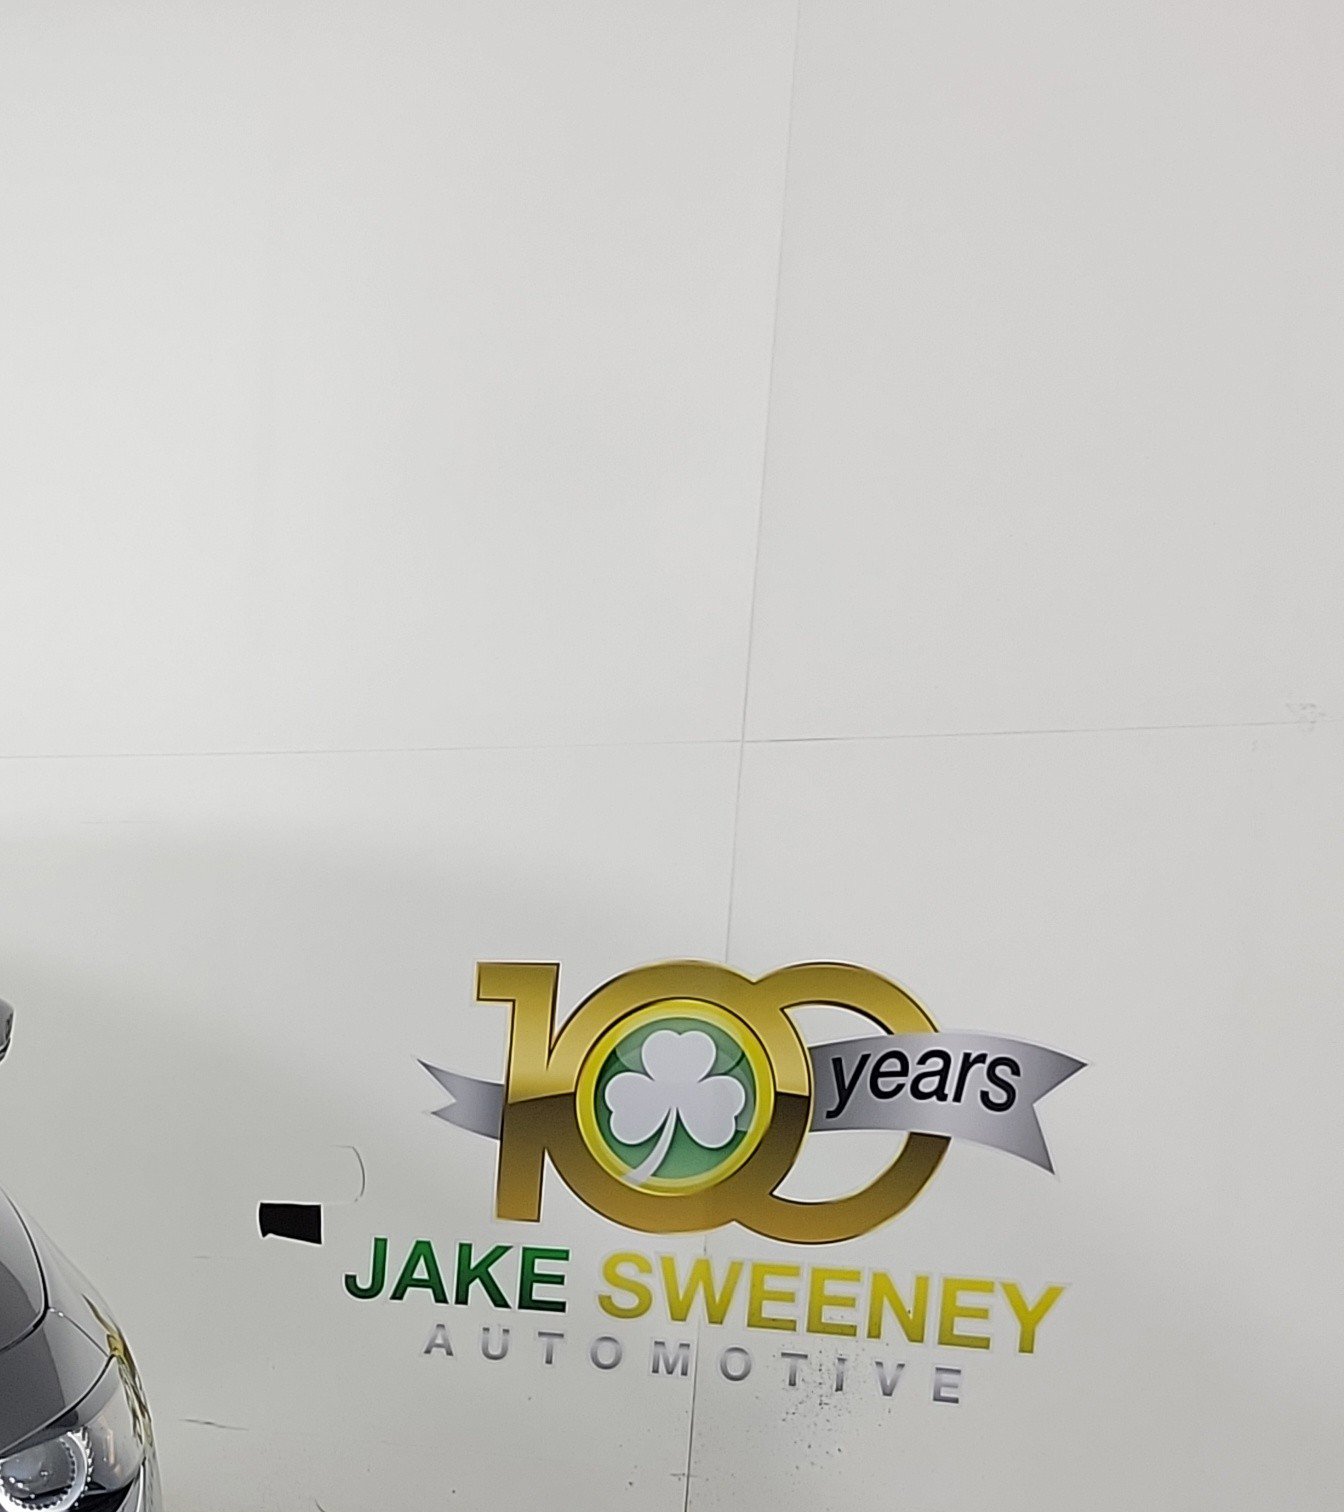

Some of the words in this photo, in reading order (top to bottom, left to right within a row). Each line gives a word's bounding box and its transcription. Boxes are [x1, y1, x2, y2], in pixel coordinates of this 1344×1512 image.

[825, 1048, 1022, 1121] years
[344, 1237, 570, 1314] JAKE
[598, 1250, 1066, 1355] SWEENEY
[423, 1323, 963, 1405] AUTOMOTIVE
